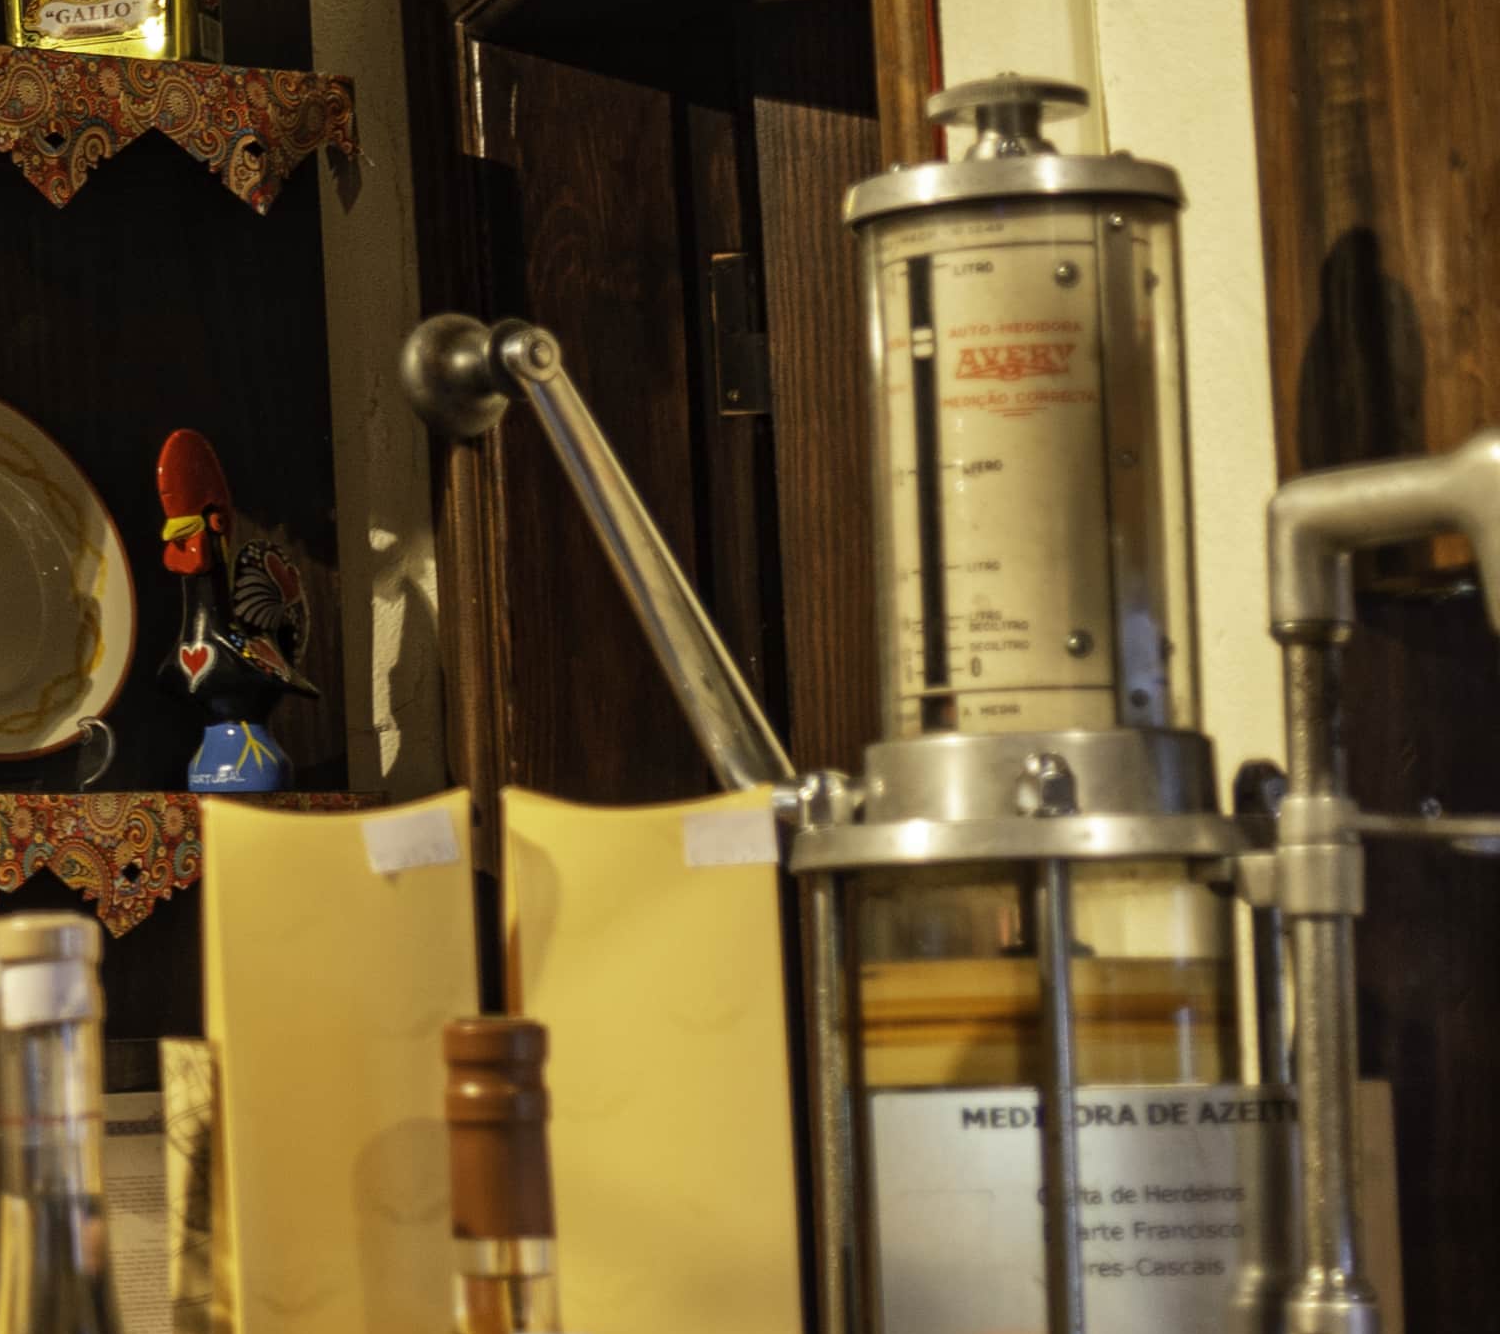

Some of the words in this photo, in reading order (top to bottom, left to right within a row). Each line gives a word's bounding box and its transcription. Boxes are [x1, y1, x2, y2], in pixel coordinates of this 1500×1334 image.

[953, 260, 995, 276] LITRO
[959, 342, 1077, 369] AVERY
[960, 1105, 1138, 1130] MEDIORA
[1148, 1103, 1188, 1127] DE
[1110, 1185, 1137, 1204] de
[1144, 1184, 1245, 1205] Herdeiros
[1133, 1221, 1245, 1241] Francisco
